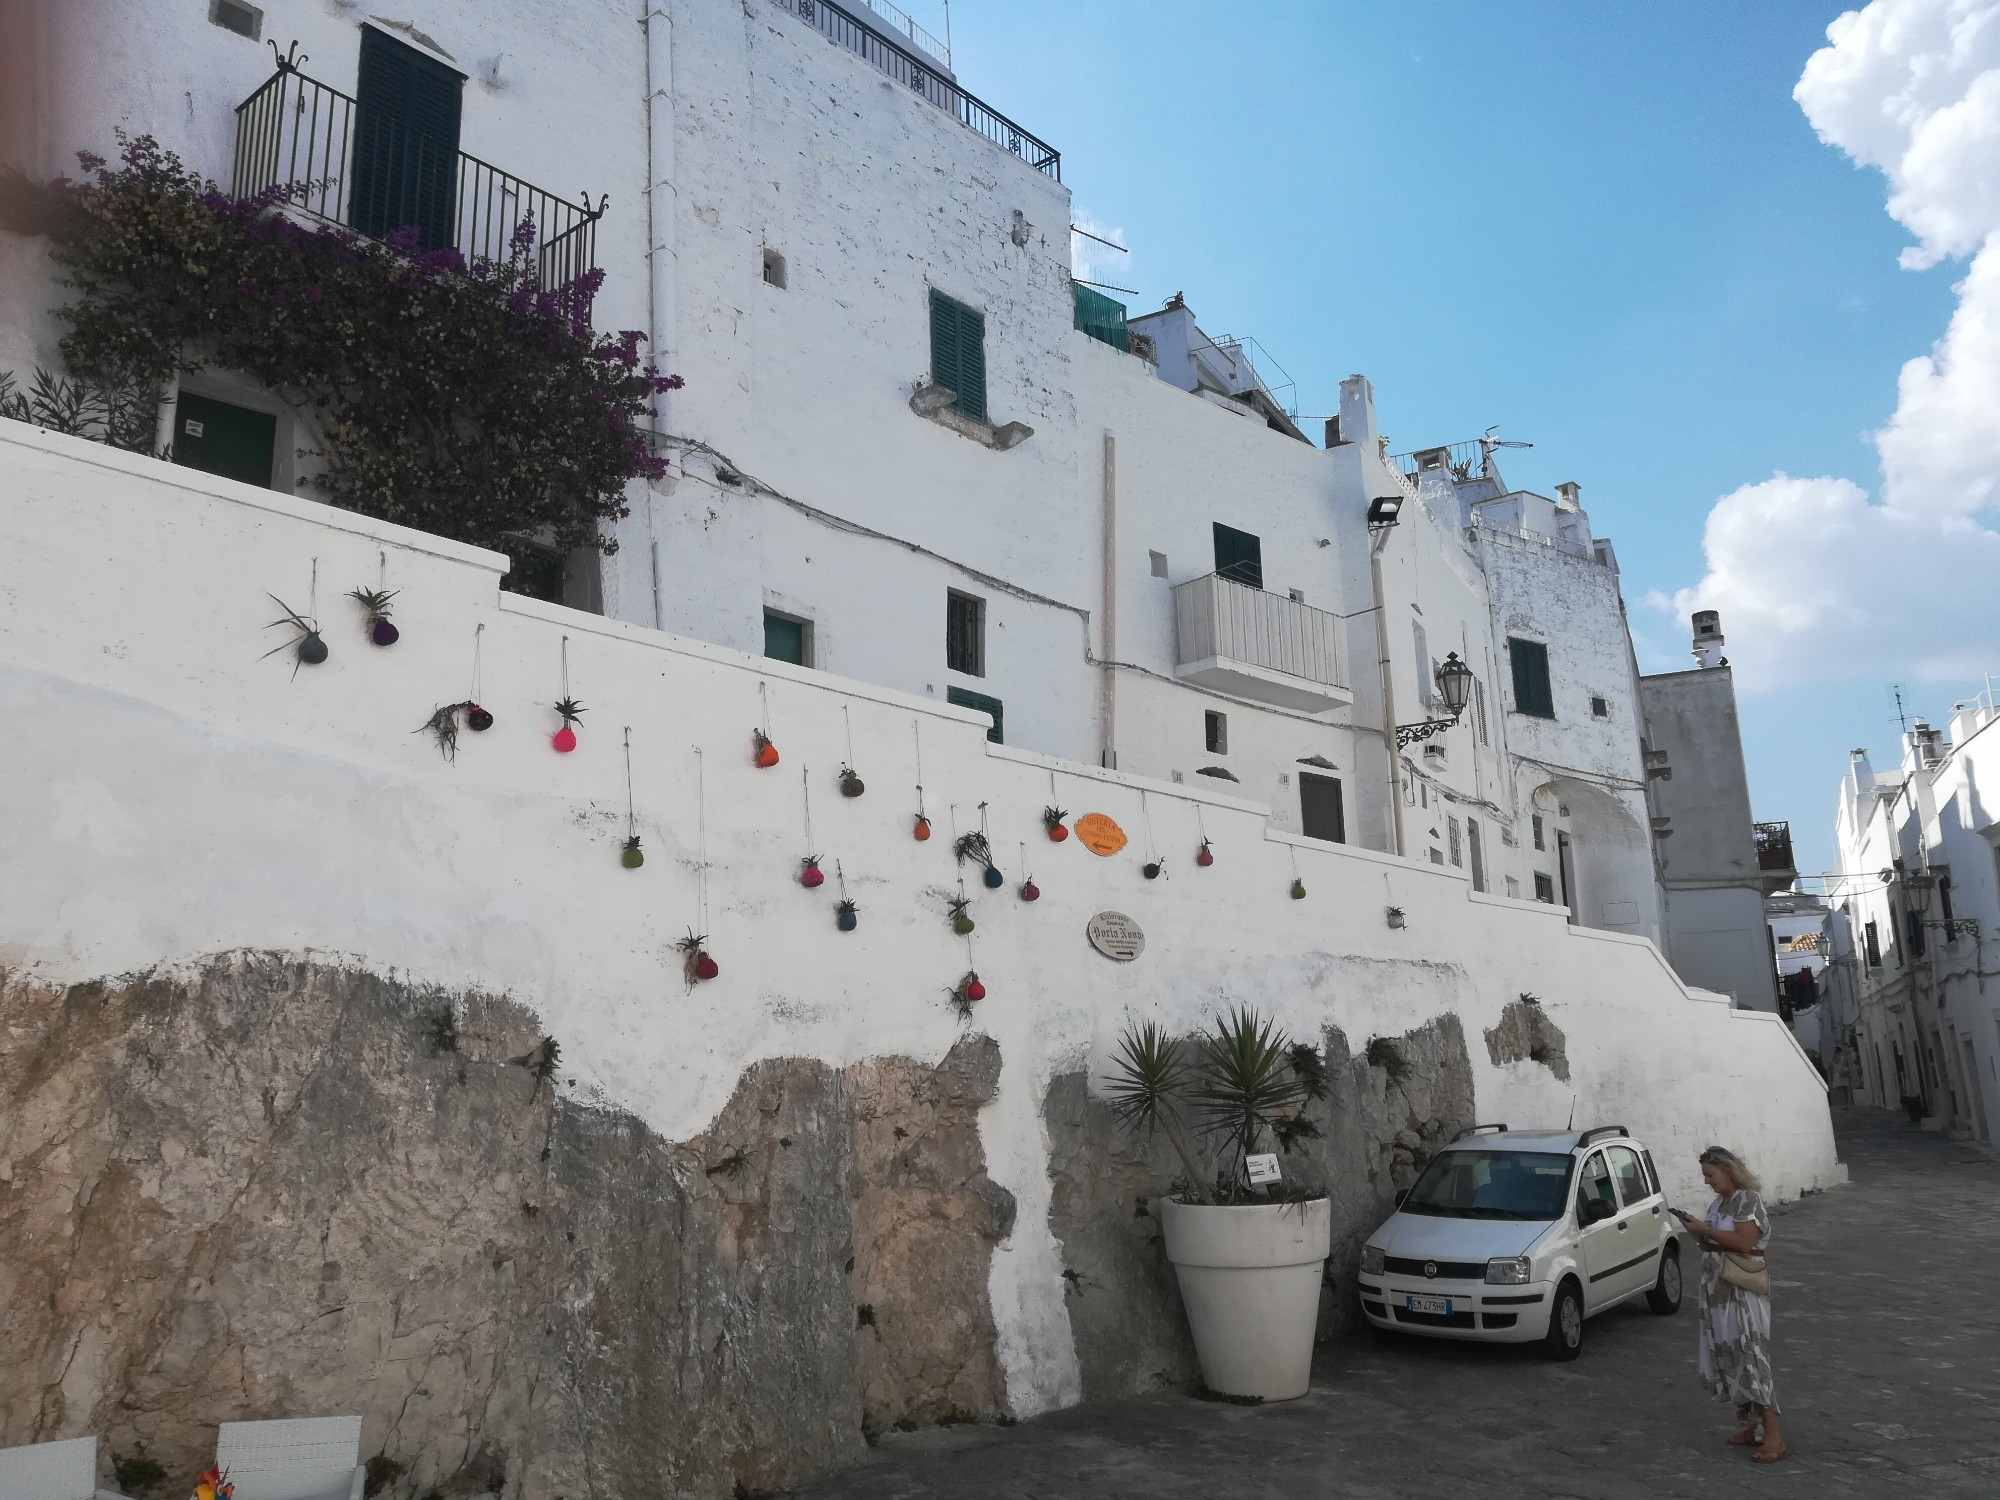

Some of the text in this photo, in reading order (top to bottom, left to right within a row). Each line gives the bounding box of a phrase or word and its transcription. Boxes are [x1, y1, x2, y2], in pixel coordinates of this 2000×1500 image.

[1087, 817, 1116, 832] OSTERIA
[1098, 912, 1130, 923] Ristorante
[1093, 926, 1142, 941] Porta Nova
[1423, 1301, 1446, 1312] 473HR
